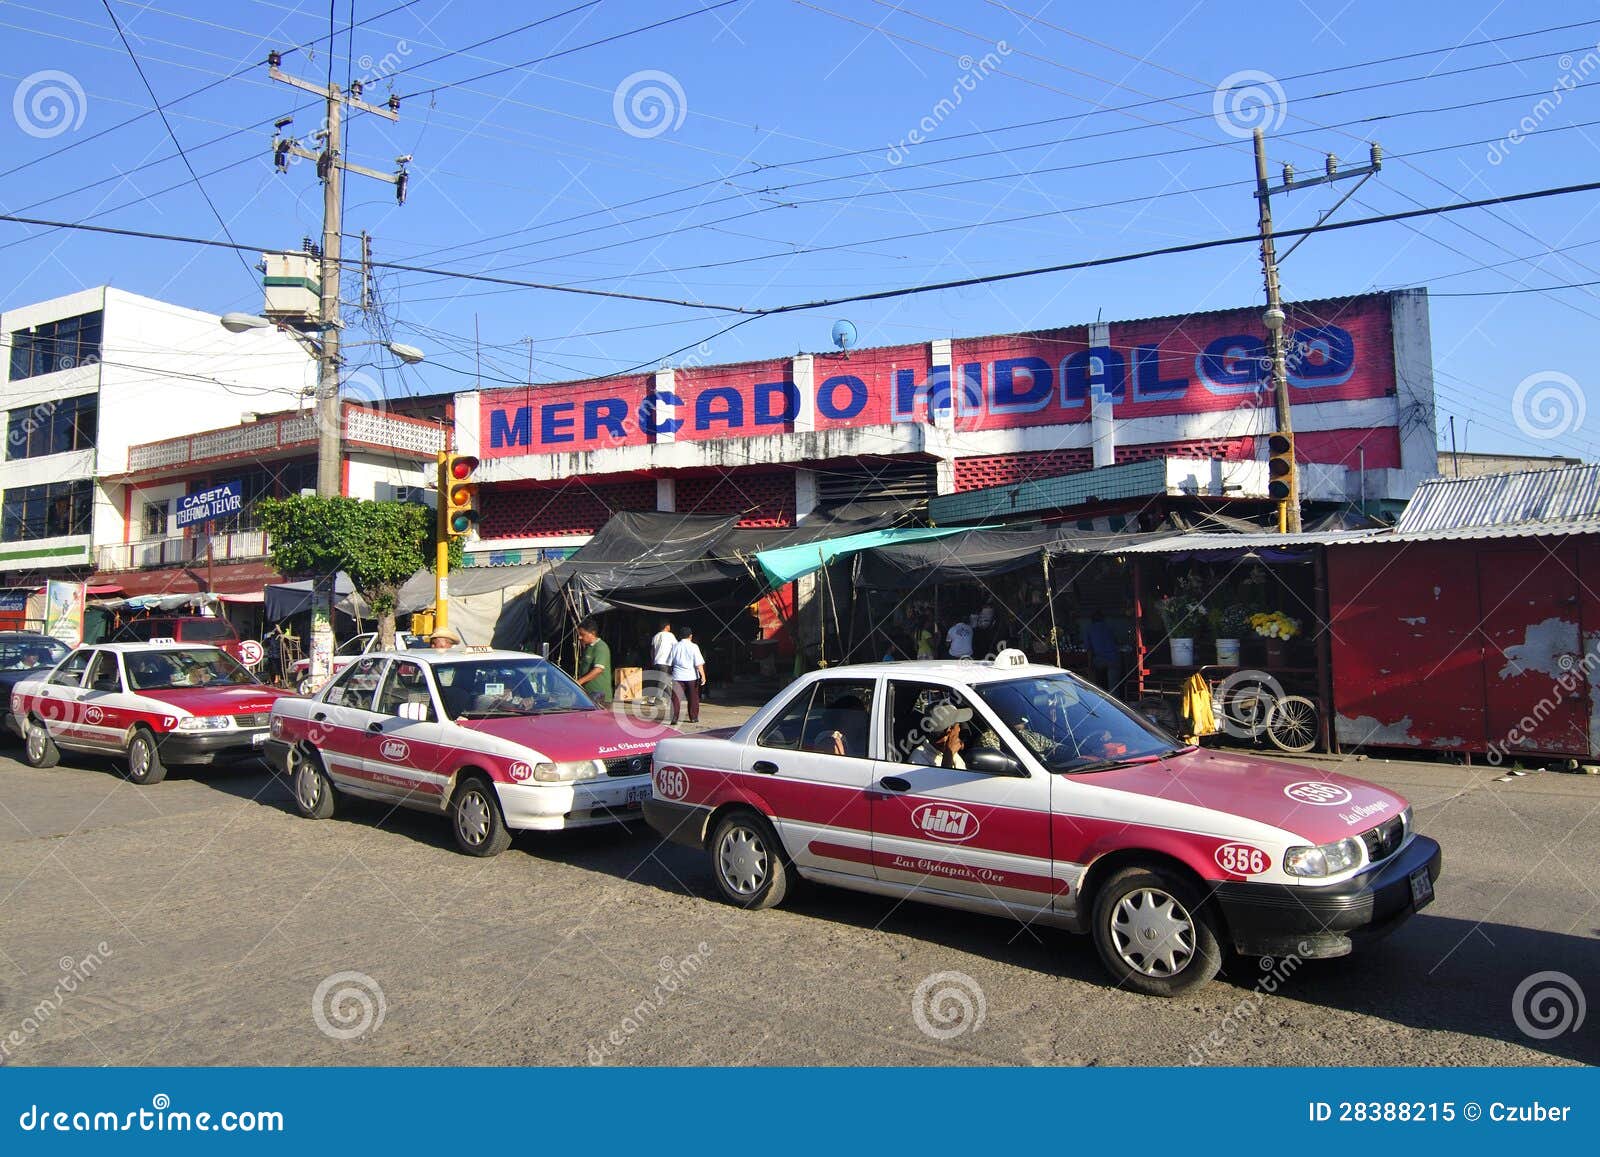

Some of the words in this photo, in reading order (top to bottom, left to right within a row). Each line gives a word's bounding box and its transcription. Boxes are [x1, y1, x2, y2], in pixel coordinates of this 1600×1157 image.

[490, 374, 868, 449] MERCADO
[890, 324, 1355, 423] HIDALGO
[183, 486, 232, 508] CASETA
[164, 717, 175, 727] 17
[599, 745, 617, 754] Las
[513, 764, 530, 778] 141
[660, 769, 683, 797] 356
[892, 856, 915, 868] Las
[1223, 846, 1263, 873] 356
